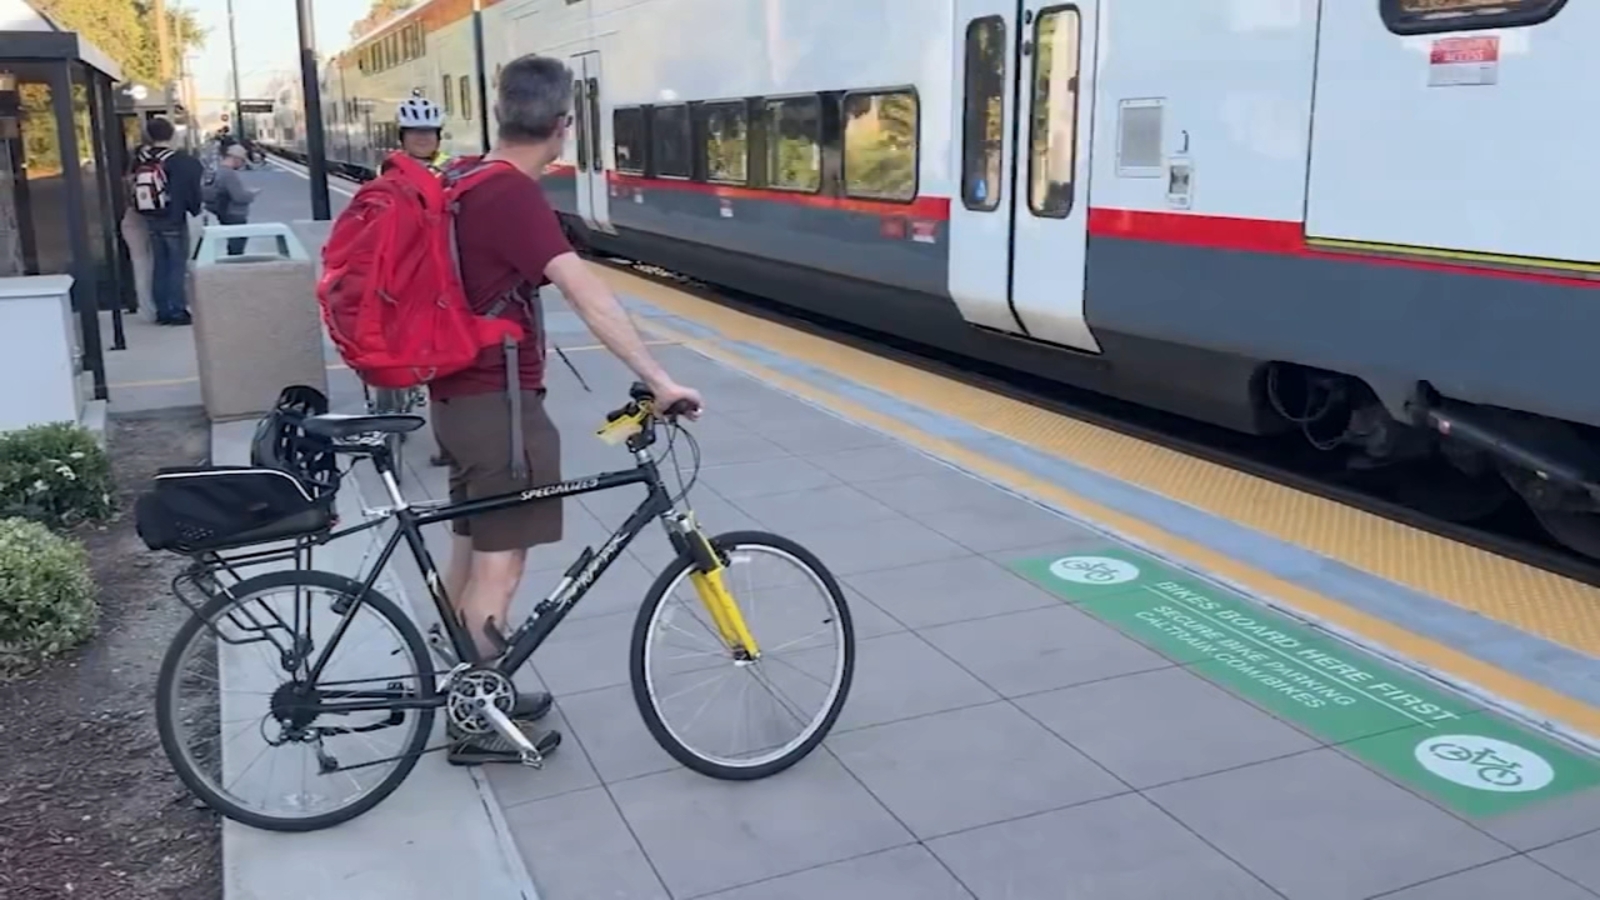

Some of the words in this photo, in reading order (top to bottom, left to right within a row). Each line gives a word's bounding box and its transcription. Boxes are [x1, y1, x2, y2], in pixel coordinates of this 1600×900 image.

[520, 478, 599, 501] SPECIALIZED
[1134, 610, 1326, 708] CALTRAIN.COM/BIKES
[1152, 605, 1226, 639] SECURE
[1217, 639, 1270, 662] BIKE
[1262, 661, 1357, 706] PARKING
[1154, 580, 1221, 611] BIKES
[1216, 609, 1301, 648] BOARD
[1297, 648, 1375, 683] HERE
[1367, 682, 1461, 721] FIRST
